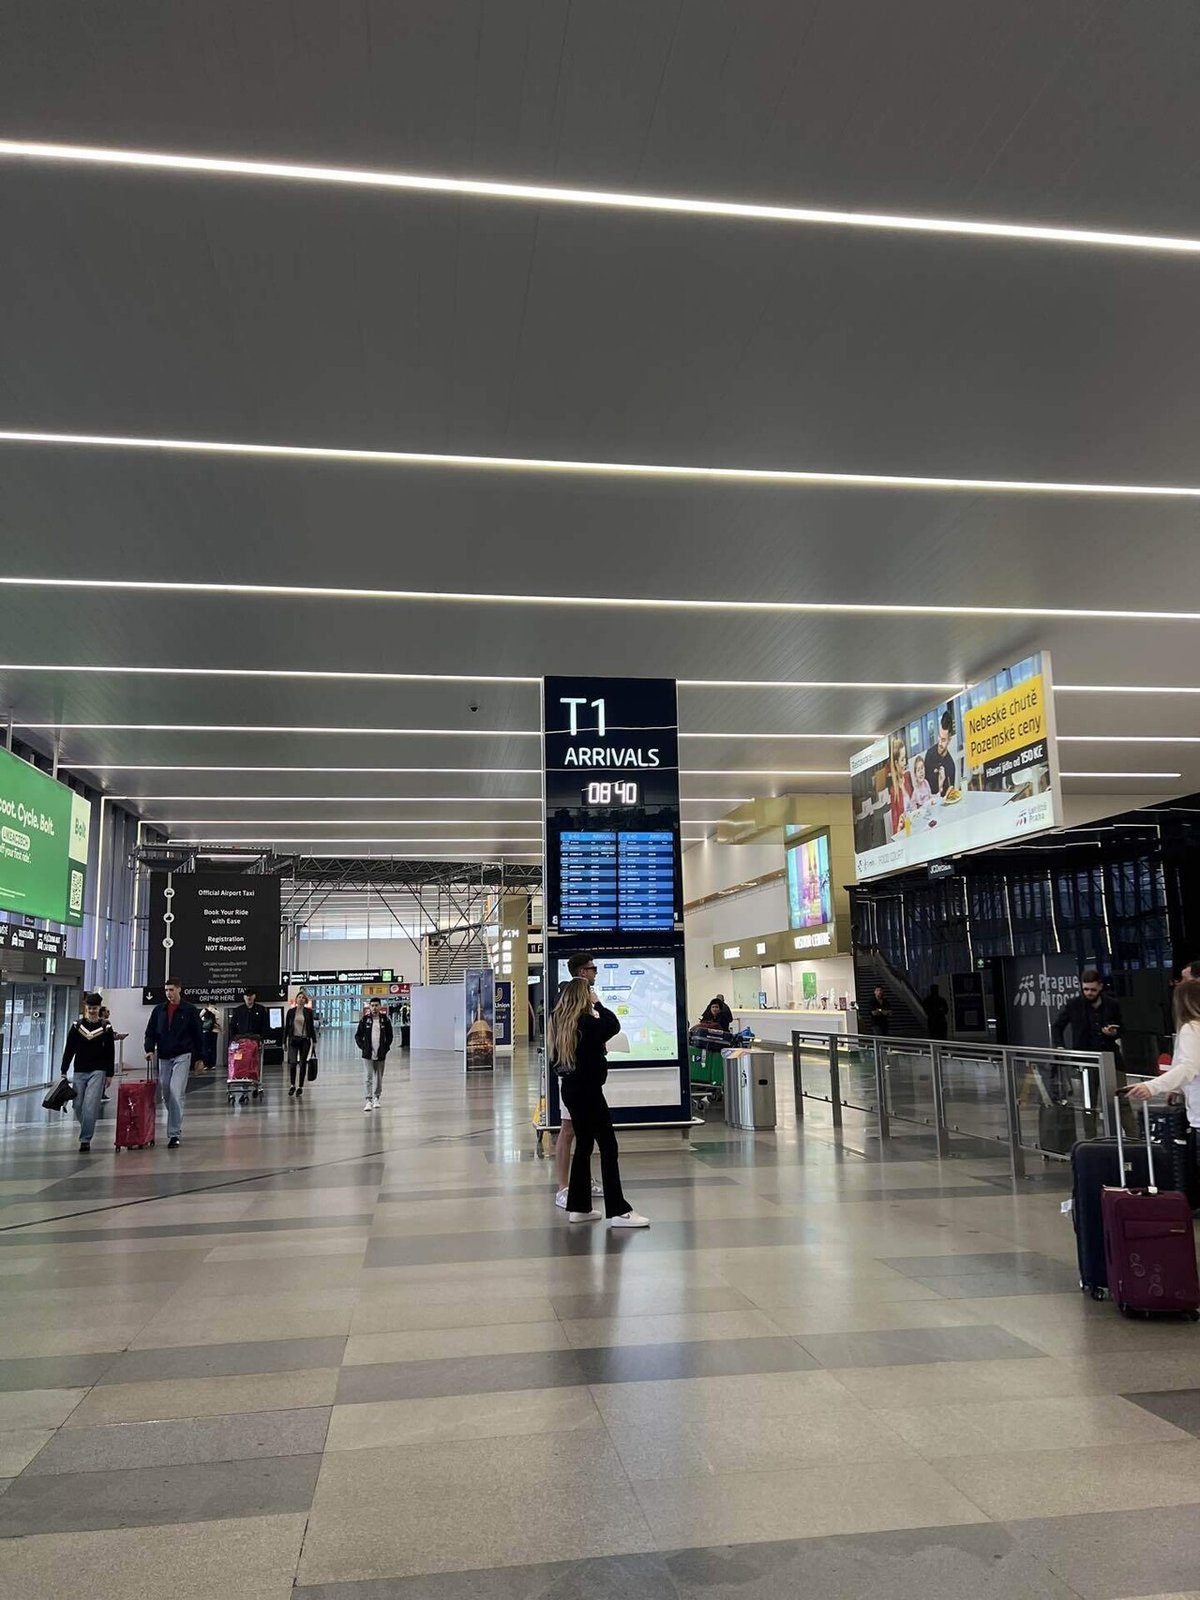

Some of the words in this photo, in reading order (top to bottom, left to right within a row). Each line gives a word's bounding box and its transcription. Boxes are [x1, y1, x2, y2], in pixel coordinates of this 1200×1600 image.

[559, 698, 605, 736] T1
[969, 702, 1007, 735] Nebeské
[1009, 688, 1037, 716] chutě
[970, 723, 1015, 757] Pozemské
[1018, 714, 1041, 737] ceny
[564, 747, 660, 767] ARRIVALS
[221, 890, 242, 898] Airport
[207, 936, 245, 944] Registration
[219, 945, 246, 953] Required
[1038, 974, 1079, 992] Prague
